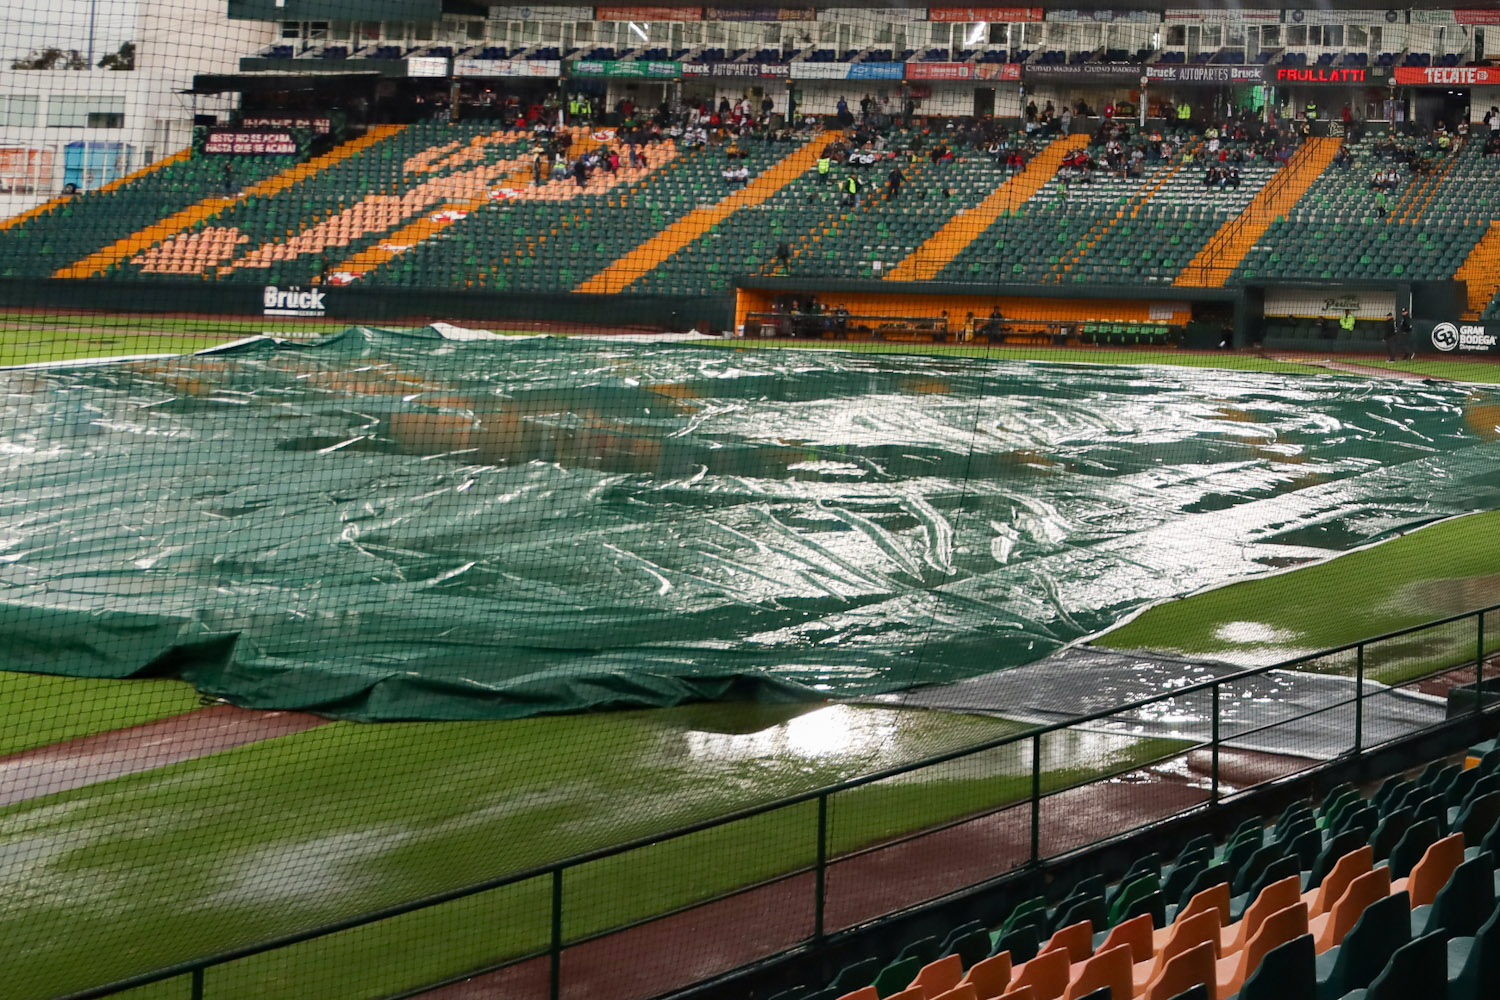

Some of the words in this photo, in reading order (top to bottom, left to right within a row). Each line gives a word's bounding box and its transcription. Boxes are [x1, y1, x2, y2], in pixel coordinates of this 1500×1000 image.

[712, 64, 758, 76] AUTOPARTES
[1179, 68, 1228, 80] AUTOPARTES
[1277, 69, 1365, 82] FRULLATTI
[1424, 68, 1478, 83] TECATE
[235, 134, 249, 142] NO
[250, 134, 262, 142] SE
[205, 144, 232, 152] HASTA
[233, 144, 252, 152] QUE
[253, 144, 264, 152] SE
[264, 286, 327, 309] Brück
[1460, 326, 1484, 335] GRAN
[1460, 335, 1497, 345] BODEGA
